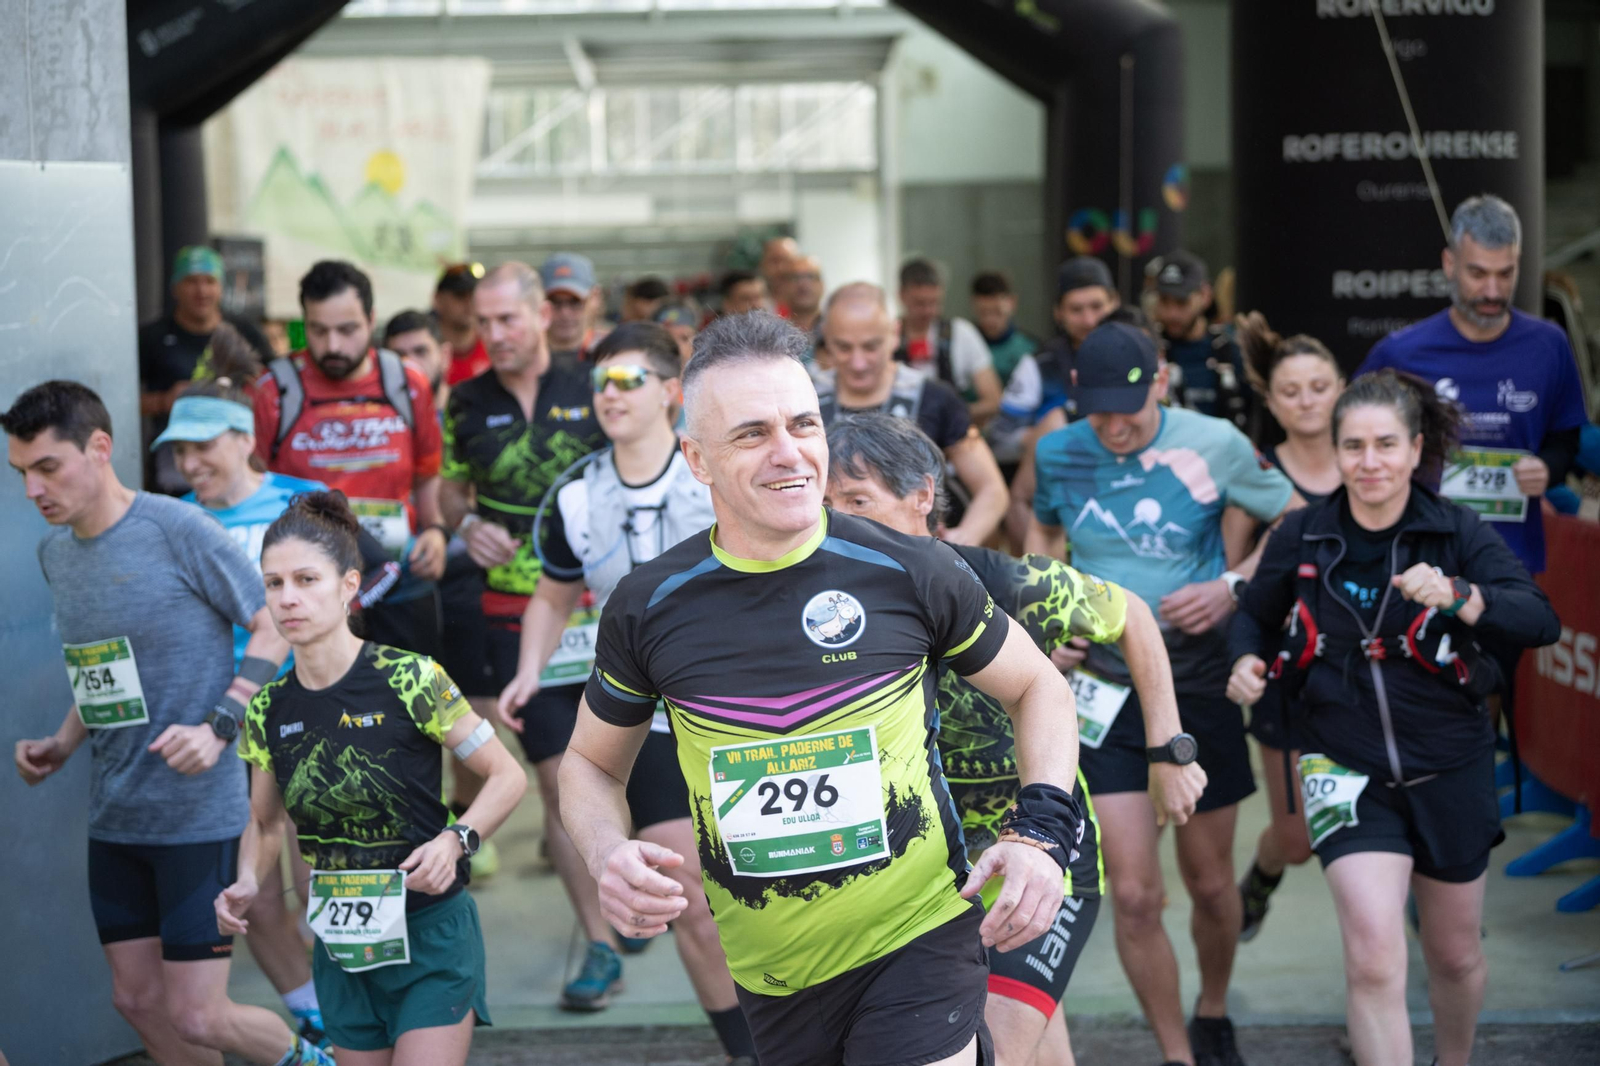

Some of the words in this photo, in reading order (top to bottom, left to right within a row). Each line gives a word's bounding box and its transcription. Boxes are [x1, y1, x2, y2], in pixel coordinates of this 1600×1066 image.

[1282, 130, 1520, 163] ROFEROURENSE
[1466, 469, 1507, 486] 298
[562, 632, 591, 648] 01
[821, 651, 858, 664] CLUB
[81, 667, 115, 690] 254
[726, 751, 741, 764] VII
[743, 747, 778, 762] TRAIL
[781, 738, 835, 757] PADERNE
[837, 735, 854, 748] DE
[766, 756, 817, 775] ALLARIZ
[758, 774, 839, 816] 296
[782, 817, 796, 825] EDU
[798, 813, 821, 823] ULLOA
[329, 901, 373, 926] 279
